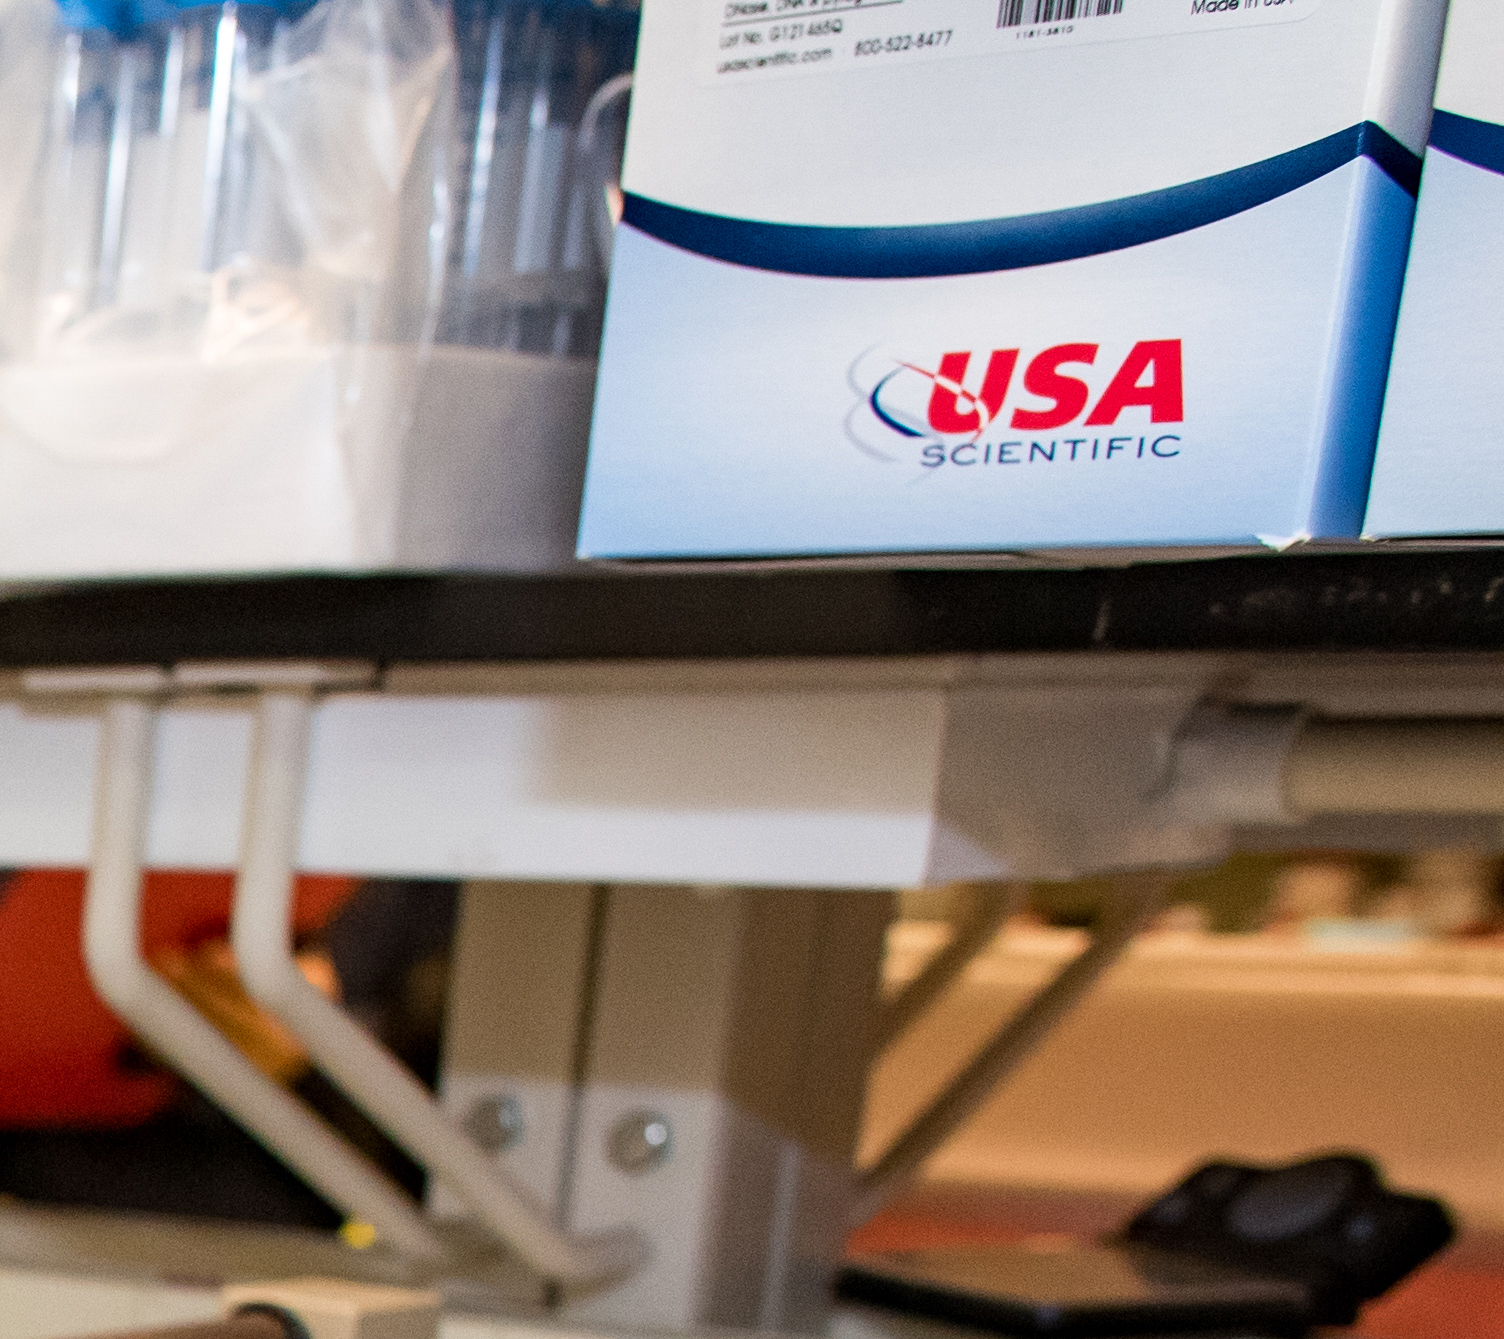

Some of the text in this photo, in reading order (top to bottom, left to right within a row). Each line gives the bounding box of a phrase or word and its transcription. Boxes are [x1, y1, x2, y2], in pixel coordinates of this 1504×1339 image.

[1190, 0, 1239, 16] Made
[928, 338, 1184, 434] USA
[920, 434, 1182, 468] SCIENTIFIC
